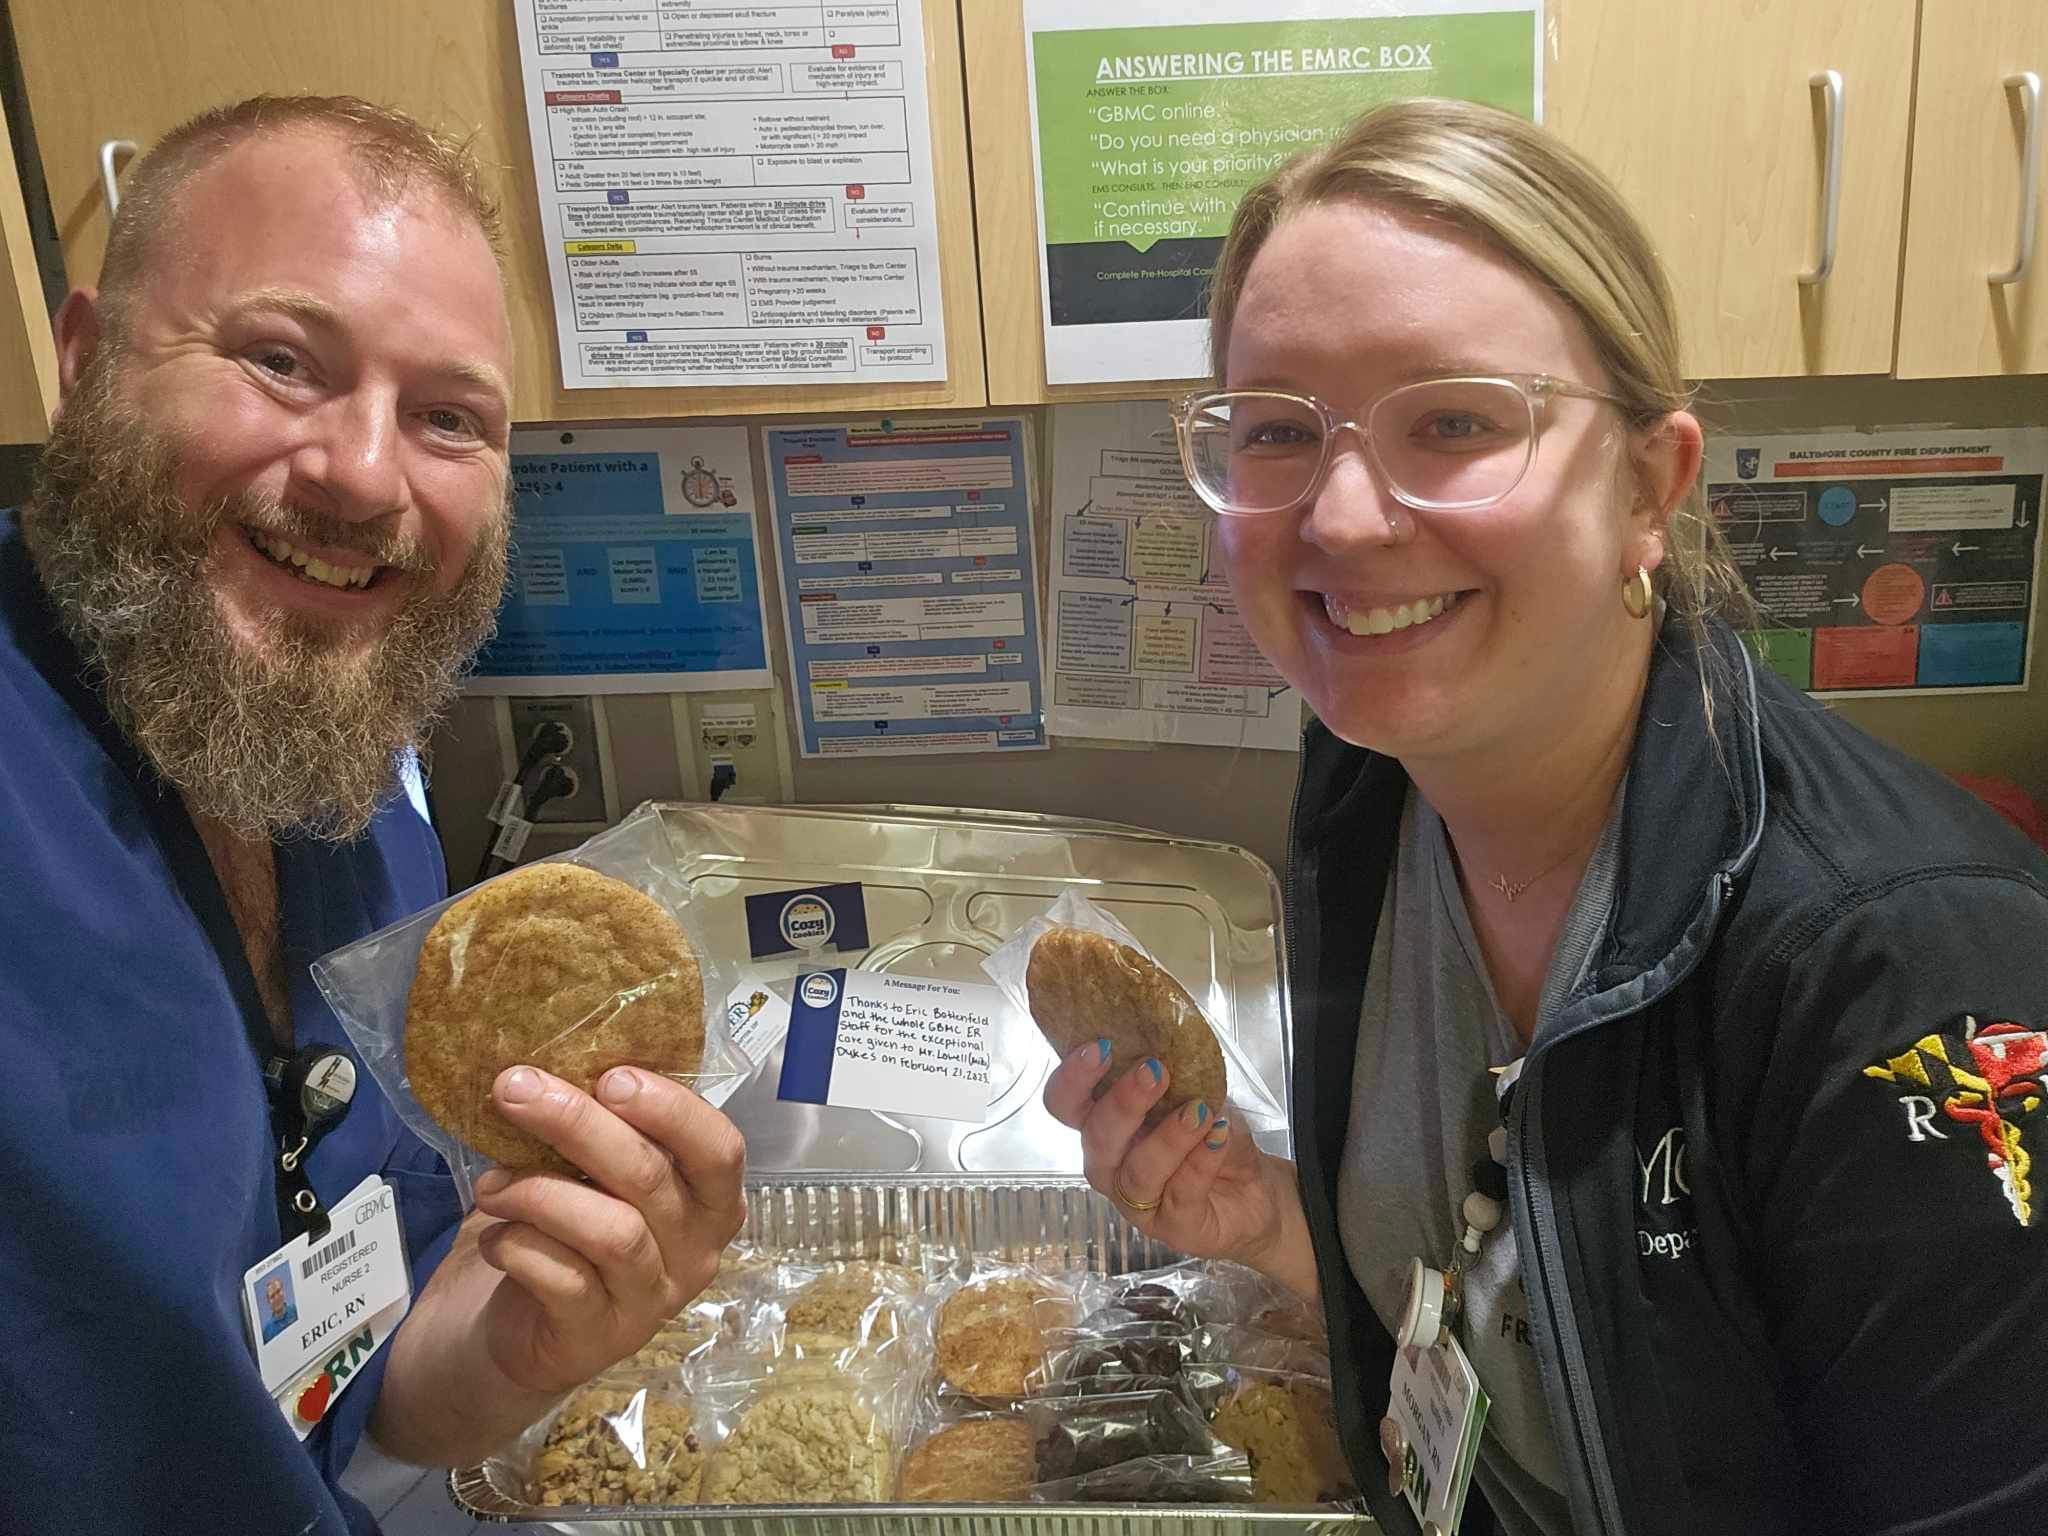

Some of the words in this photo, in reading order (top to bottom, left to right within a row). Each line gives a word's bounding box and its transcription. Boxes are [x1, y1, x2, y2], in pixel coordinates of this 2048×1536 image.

[835, 9, 864, 18] Paralysis
[808, 65, 836, 73] Evaluate
[838, 64, 847, 72] for
[848, 64, 877, 72] evidence
[1096, 51, 1245, 79] ANSWERING
[1251, 49, 1293, 73] THE
[1301, 46, 1371, 71] EMRC
[1380, 43, 1433, 68] BOX
[551, 72, 585, 82] Transport
[596, 71, 622, 79] Trauma
[624, 70, 646, 78] Center
[658, 68, 689, 78] Specialty
[691, 68, 713, 76] Center
[808, 72, 845, 80] mechanism
[855, 72, 872, 81] injury
[874, 71, 886, 79] and
[816, 80, 854, 89] high-energy
[1087, 87, 1127, 97] ANSWER
[1128, 86, 1146, 96] THE
[559, 107, 575, 115] High
[609, 105, 630, 113] Crash
[1130, 134, 1163, 153] you
[1168, 129, 1217, 148] need
[1221, 132, 1234, 145] a
[1239, 127, 1325, 148] physician
[1152, 157, 1165, 176] is
[1168, 160, 1208, 180] your
[1092, 184, 1110, 194] EMS
[851, 207, 879, 215] Evaluate
[880, 206, 890, 214] for
[890, 206, 907, 214] other
[1190, 196, 1226, 214] with
[856, 216, 903, 224] considerations.
[1094, 220, 1105, 238] if
[752, 264, 776, 272] Without
[840, 262, 860, 273] Triage
[869, 262, 885, 270] Burn
[886, 261, 907, 270] Center
[1096, 270, 1139, 281] Complete
[1141, 267, 1192, 279] Pre-Hospital
[757, 287, 791, 297] Pregnancy
[775, 299, 801, 307] Provider
[866, 347, 896, 355] Transport
[897, 347, 927, 355] according
[1789, 448, 1847, 460] BALTIMORE
[1849, 447, 1893, 459] COUNTY
[1894, 446, 1918, 457] FIRE
[1919, 445, 1992, 457] DEPARTMENT
[550, 460, 603, 475] Patient
[605, 460, 636, 473] with
[640, 462, 649, 473] a
[555, 481, 564, 492] 4
[790, 918, 825, 935] Cozy
[792, 928, 825, 940] Cookies
[807, 986, 830, 998] Cozy
[891, 980, 926, 992] Message
[927, 983, 942, 993] For
[942, 985, 961, 996] You:
[847, 996, 889, 1012] Thanks
[890, 1002, 903, 1013] to
[905, 1003, 928, 1017] Eric
[841, 1009, 866, 1020] and
[869, 1012, 889, 1024] the
[892, 1016, 925, 1030] whole
[928, 1021, 962, 1035] GBMC
[966, 1026, 982, 1038] ER
[874, 1024, 894, 1036] for
[896, 1028, 918, 1041] the
[921, 1033, 985, 1052] exceptional
[867, 1037, 899, 1051] given
[901, 1042, 914, 1053] to
[937, 1049, 967, 1064] Lowell
[836, 1046, 877, 1062] Dukes
[881, 1054, 897, 1065] on
[900, 1056, 948, 1078] February
[1898, 1094, 1949, 1143] R
[319, 1240, 378, 1284] REGISTERED
[331, 1267, 364, 1296] NURSE
[363, 1263, 371, 1275] 2
[300, 1312, 343, 1350] ERIC,
[345, 1293, 367, 1319] RN
[1501, 1312, 1532, 1347] FR
[323, 1327, 375, 1394] RN
